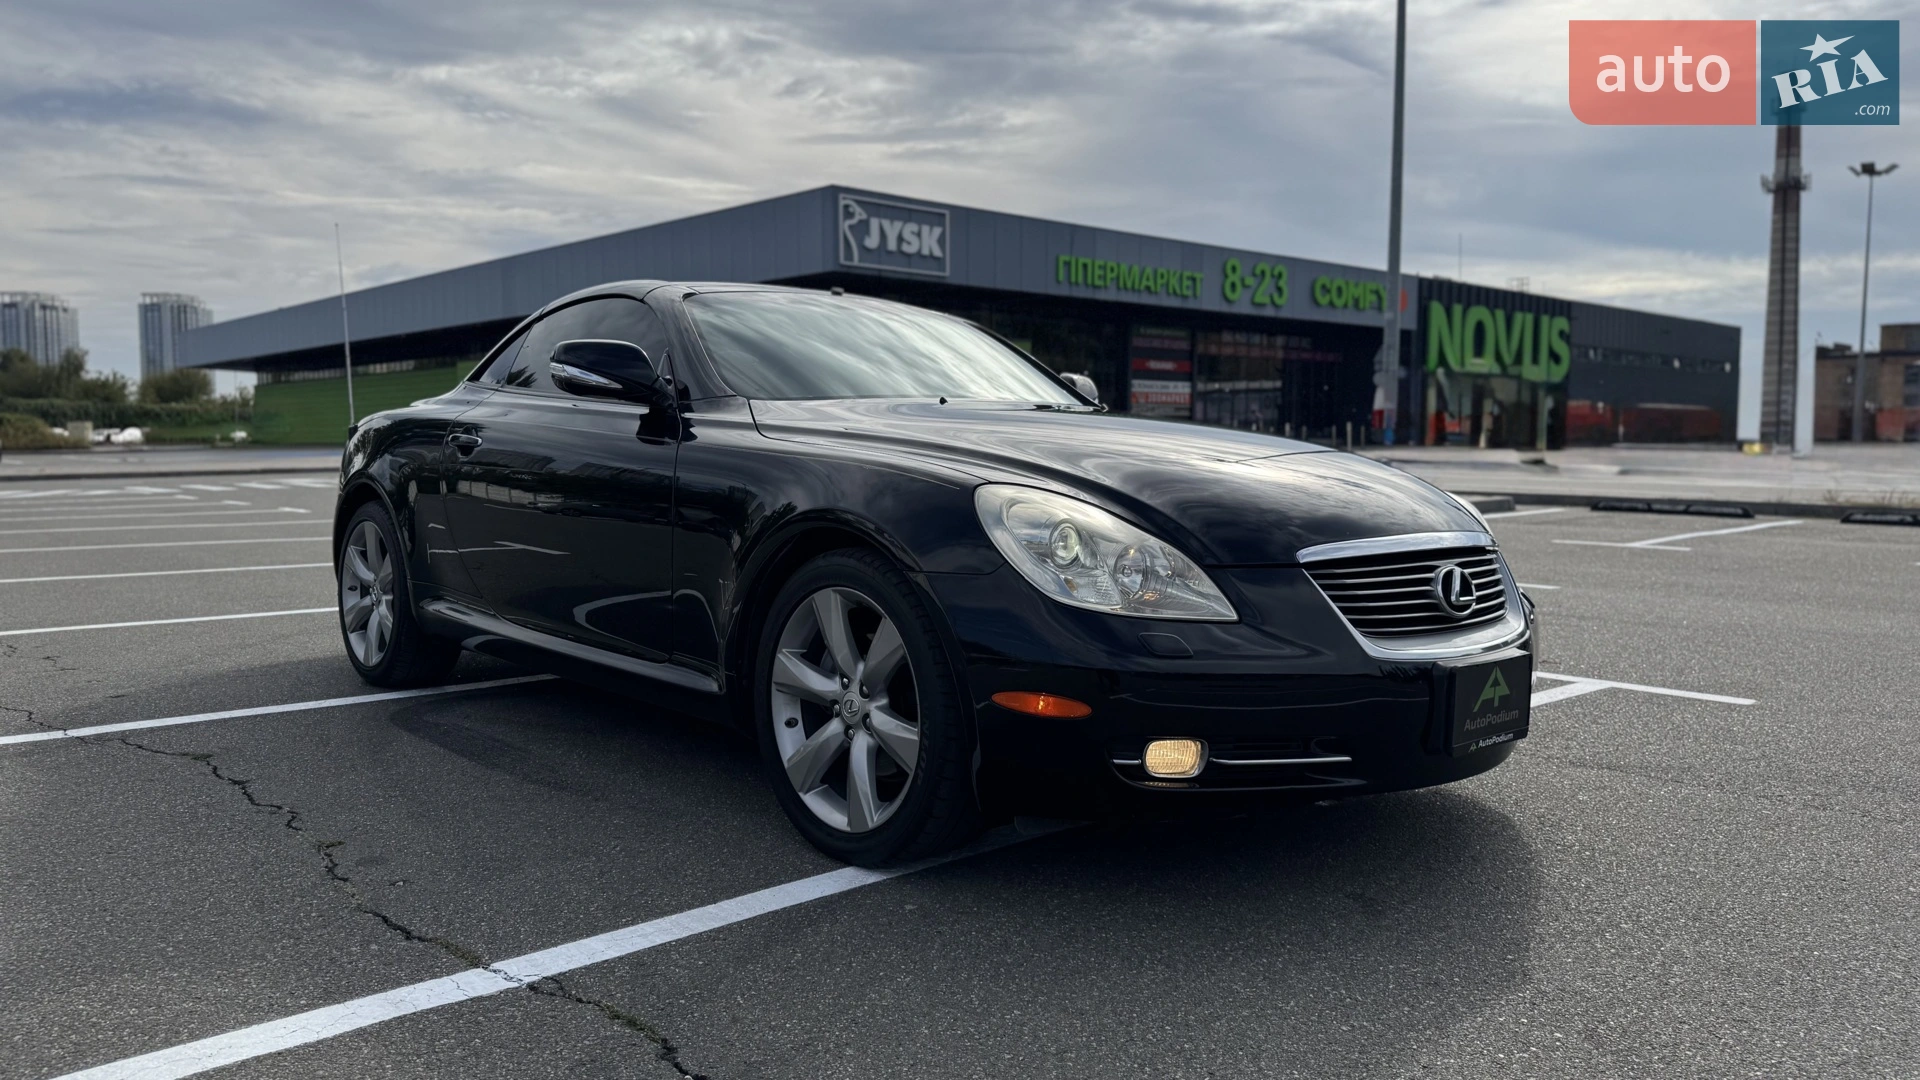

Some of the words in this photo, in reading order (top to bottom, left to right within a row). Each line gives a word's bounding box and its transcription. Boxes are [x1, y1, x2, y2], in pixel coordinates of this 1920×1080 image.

[863, 216, 943, 258] JYSK
[1057, 255, 1203, 298] ГІПЕРМАРКЕТ
[1224, 258, 1288, 306] 8-23
[1313, 275, 1387, 311] COMFY
[1426, 301, 1571, 383] NOVUS
[1463, 709, 1520, 732] AutoPodium
[1477, 732, 1514, 749] AutoPodium
